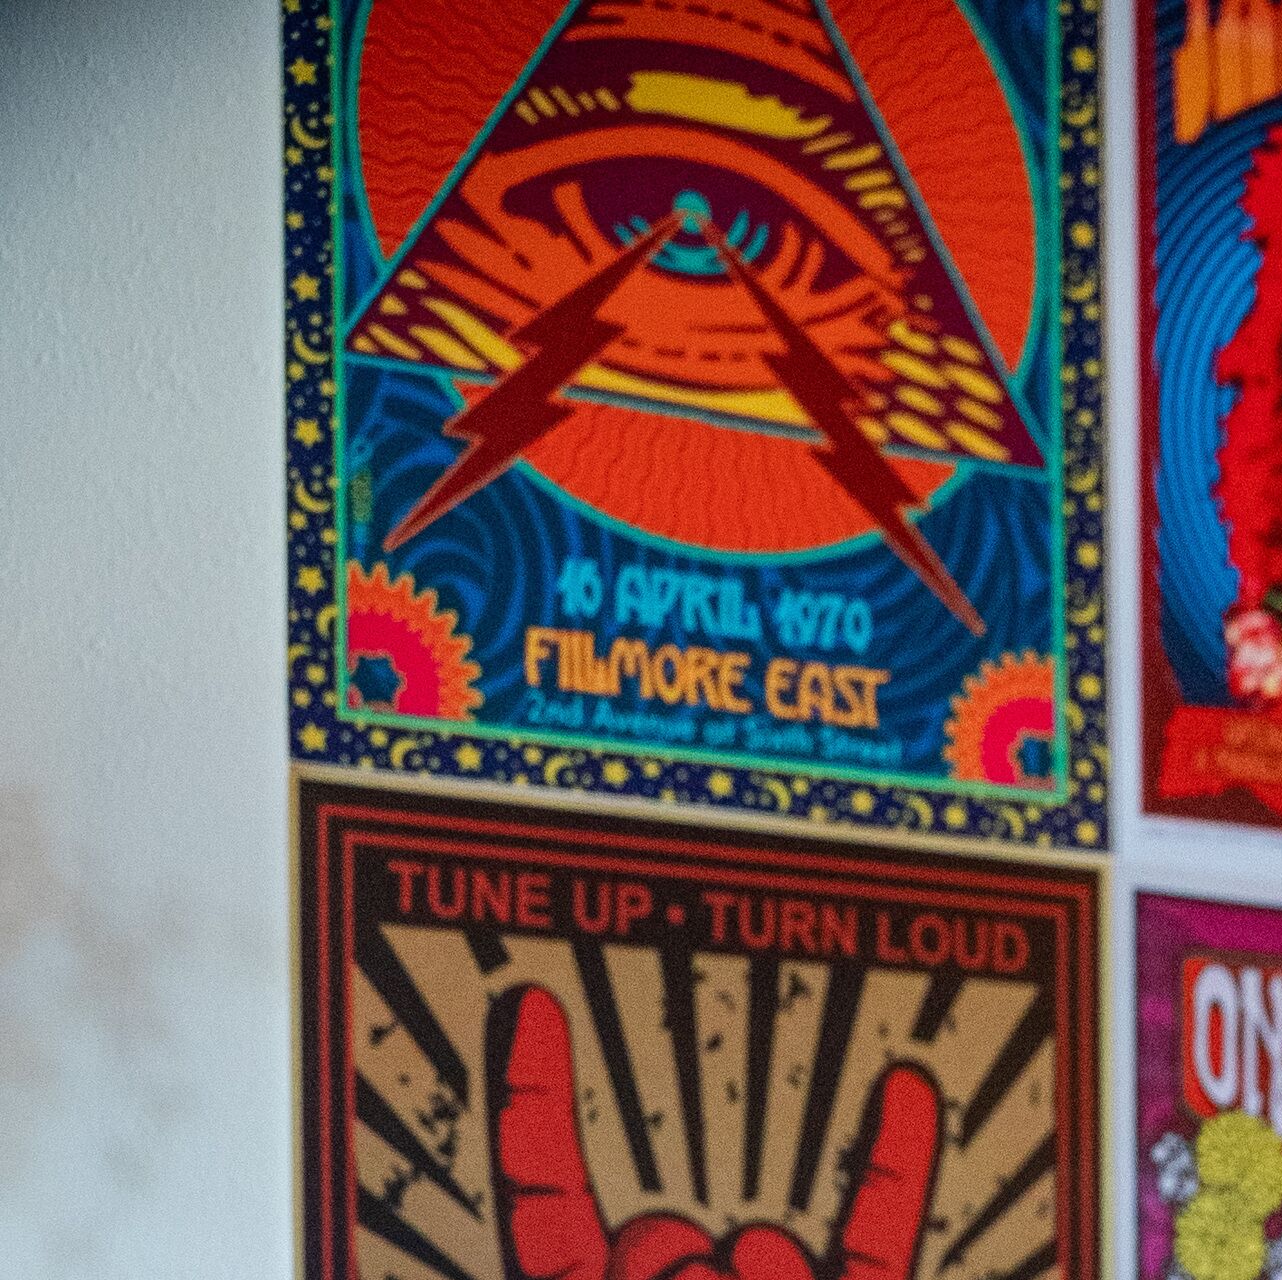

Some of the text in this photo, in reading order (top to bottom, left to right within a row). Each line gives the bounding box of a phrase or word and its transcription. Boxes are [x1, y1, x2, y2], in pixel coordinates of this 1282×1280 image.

[615, 564, 762, 641] APRIL
[775, 587, 874, 654] 1970
[765, 656, 892, 729] EAST
[388, 859, 1030, 976] TUNE UP TURN LOUD
